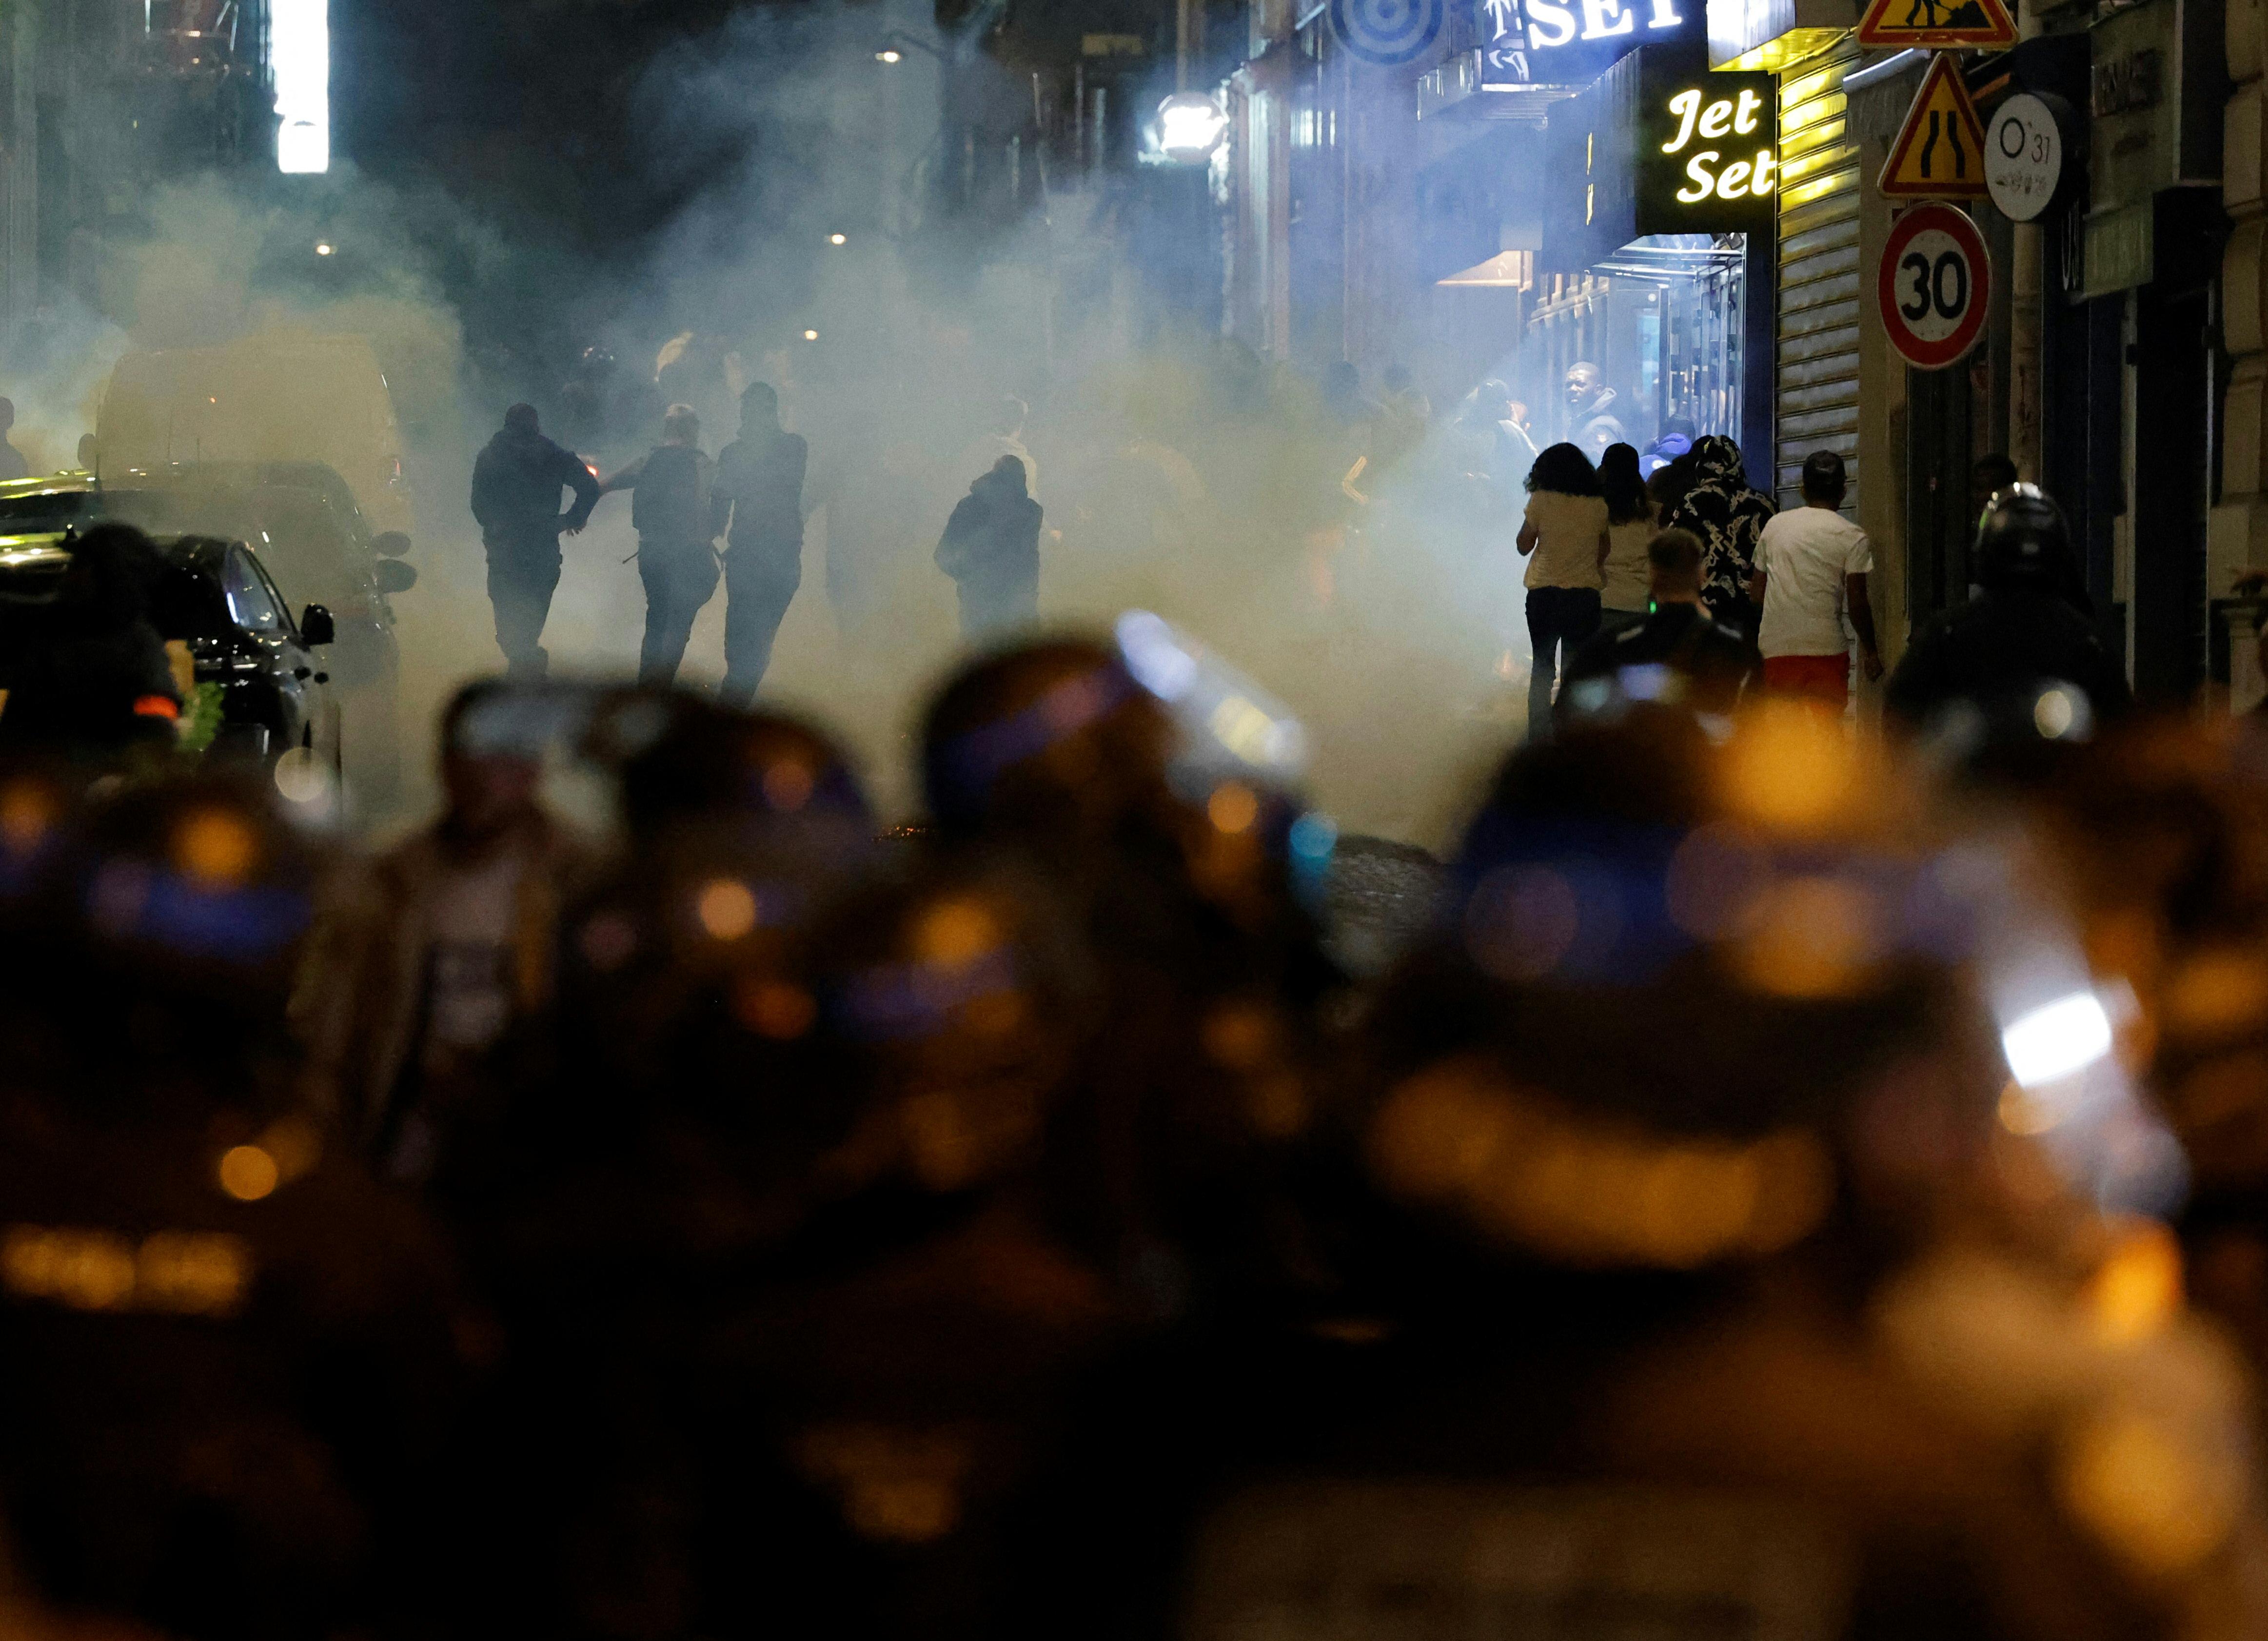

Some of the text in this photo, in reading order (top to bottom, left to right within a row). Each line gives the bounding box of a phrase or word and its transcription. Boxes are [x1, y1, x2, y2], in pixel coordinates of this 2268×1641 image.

[1661, 89, 1762, 154] Jet
[1676, 150, 1778, 203] Set
[1901, 251, 1967, 321] 30
